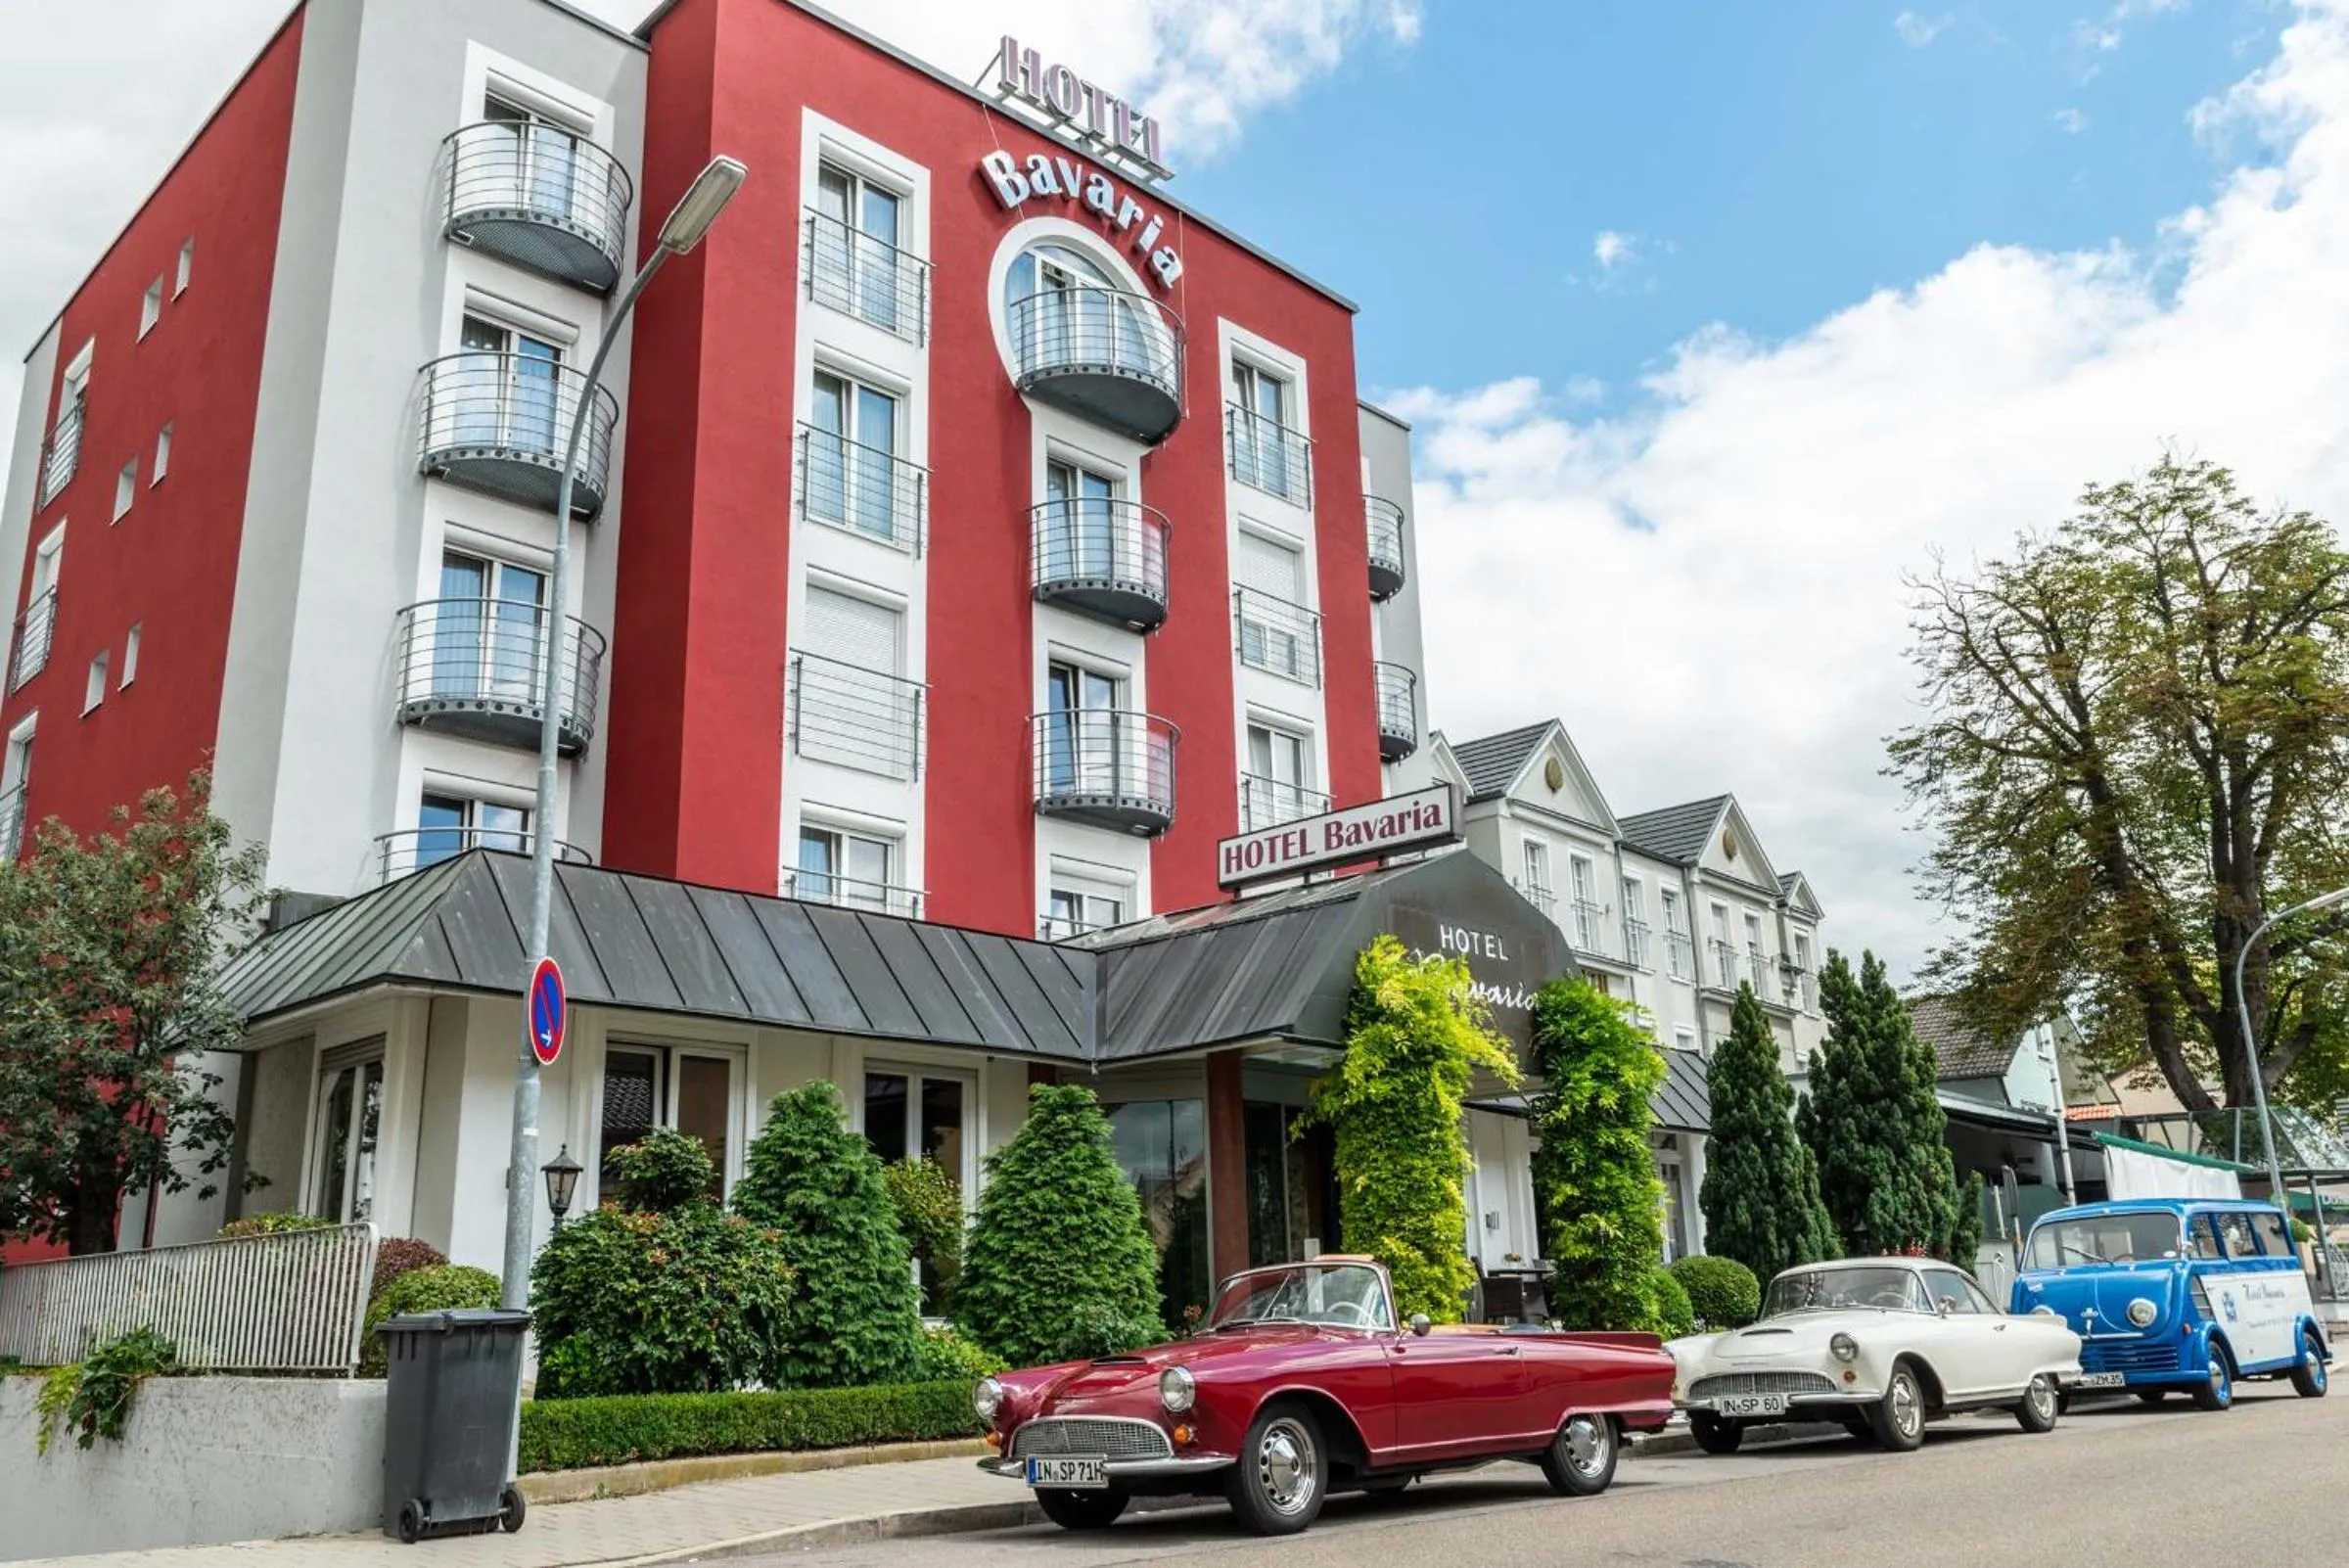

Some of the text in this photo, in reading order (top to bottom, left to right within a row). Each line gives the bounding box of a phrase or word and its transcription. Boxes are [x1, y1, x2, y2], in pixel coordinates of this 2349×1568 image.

[982, 149, 1183, 290] Bavaria
[1224, 801, 1443, 874] HOTEL Bavaria
[1440, 924, 1509, 961] HOTEL
[1764, 1398, 1779, 1411] 60
[1037, 1462, 1052, 1481] IN
[1059, 1461, 1077, 1481] SP
